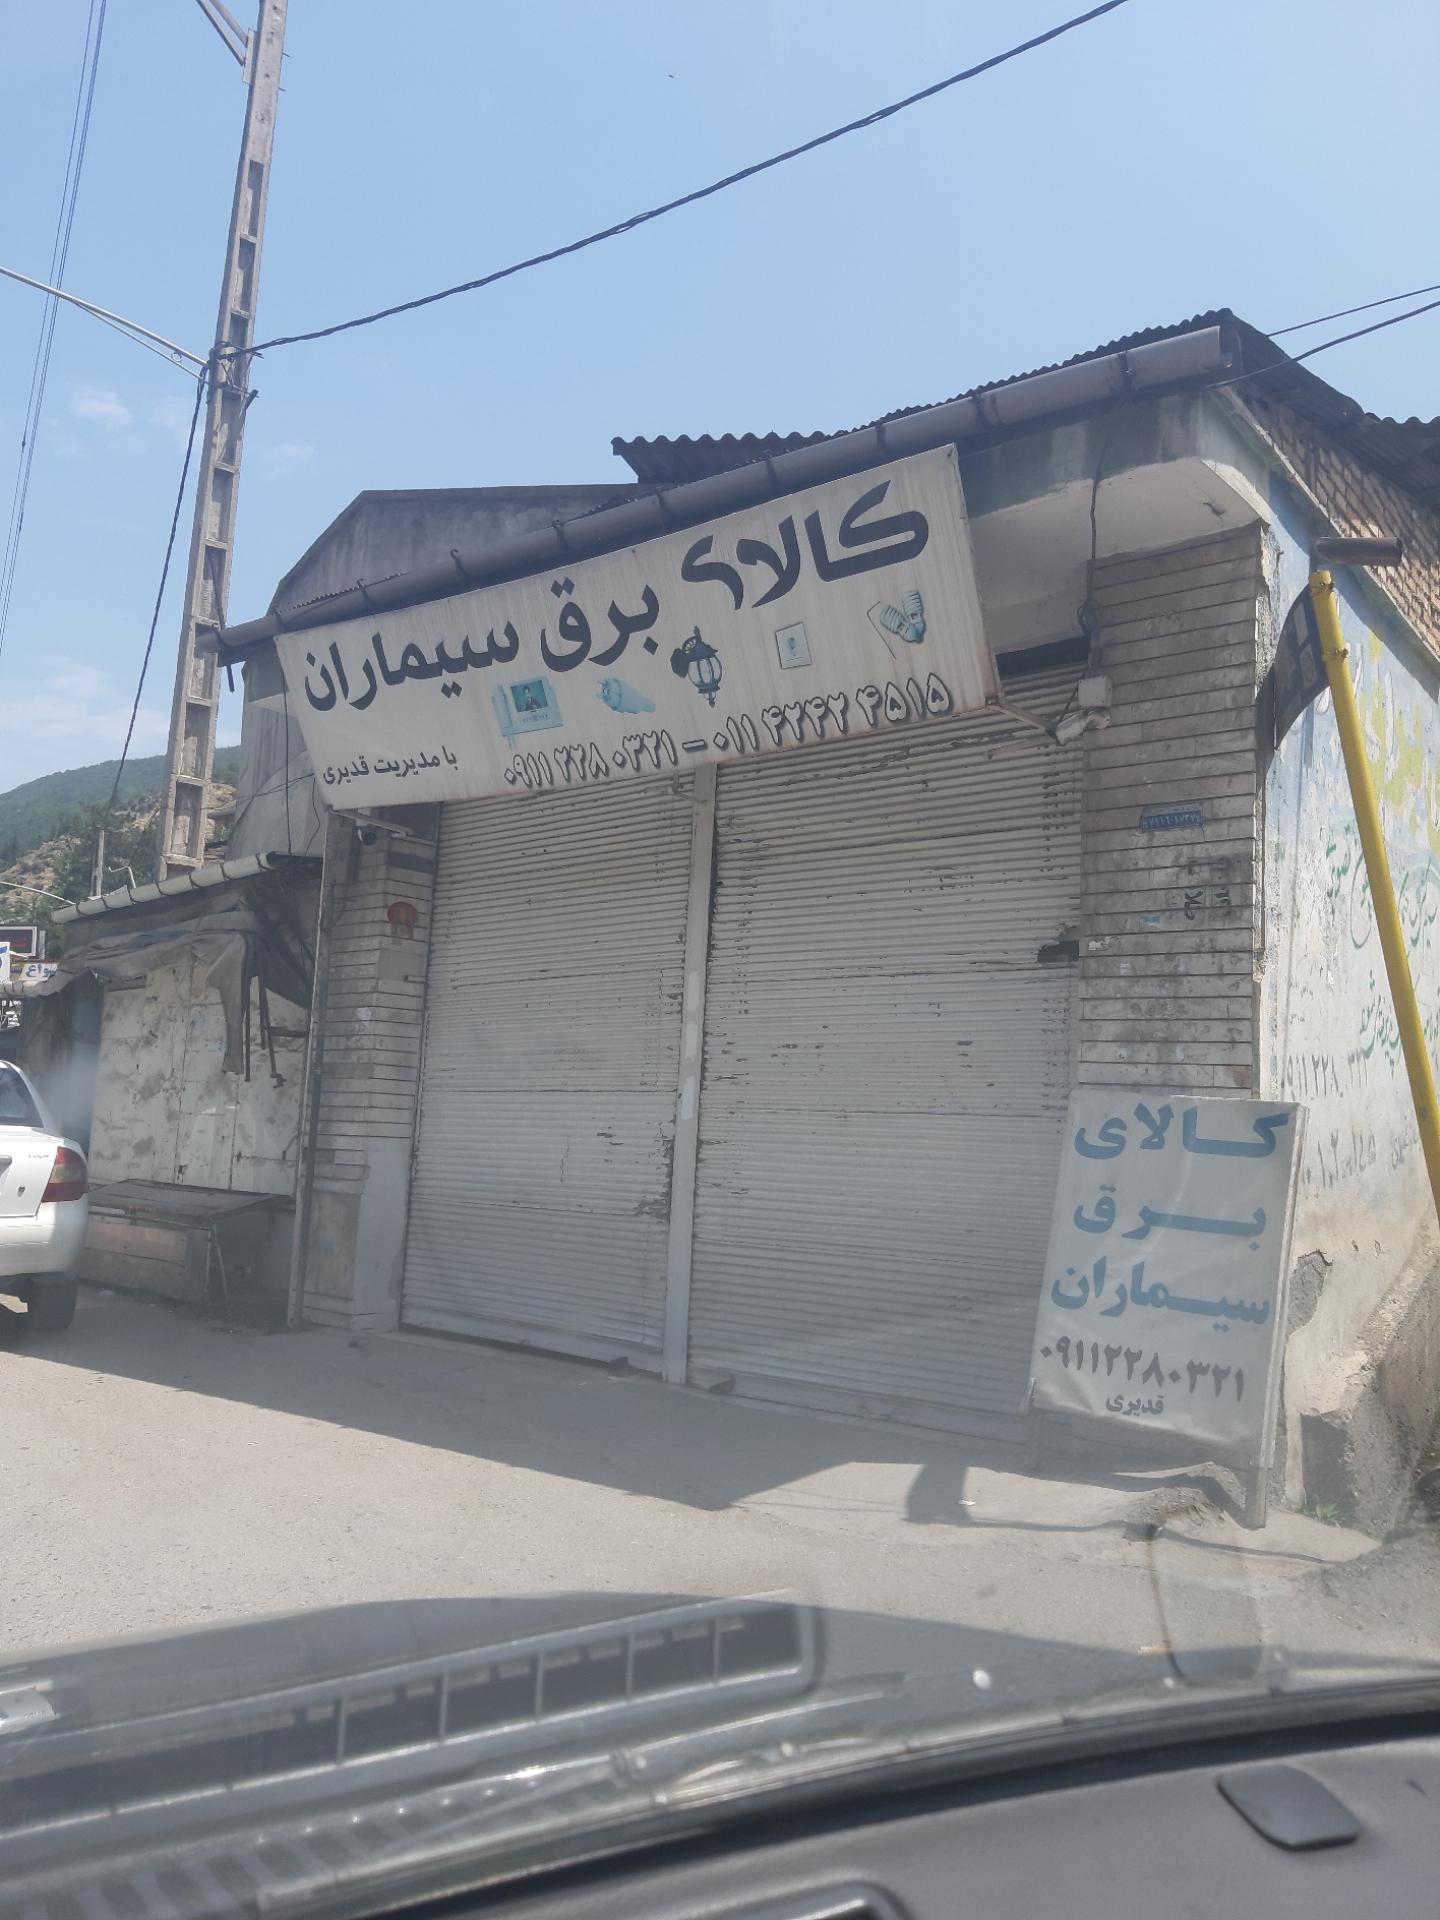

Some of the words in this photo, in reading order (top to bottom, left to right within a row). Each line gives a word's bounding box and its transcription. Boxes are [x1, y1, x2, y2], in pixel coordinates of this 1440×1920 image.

[681, 480, 929, 611] کالای
[540, 576, 660, 673] برق
[304, 620, 520, 712] سیماران
[322, 755, 370, 785] قدیری
[373, 751, 441, 778] مدیریت
[442, 745, 458, 771] با
[1074, 1102, 1290, 1160] کالای
[1073, 1183, 1267, 1250] برق
[1050, 1255, 1271, 1333] سیماران
[1040, 1335, 1245, 1402] ۰۹۱۱۲۲۸۰۳۲۱
[1106, 1394, 1165, 1417] قدیری
